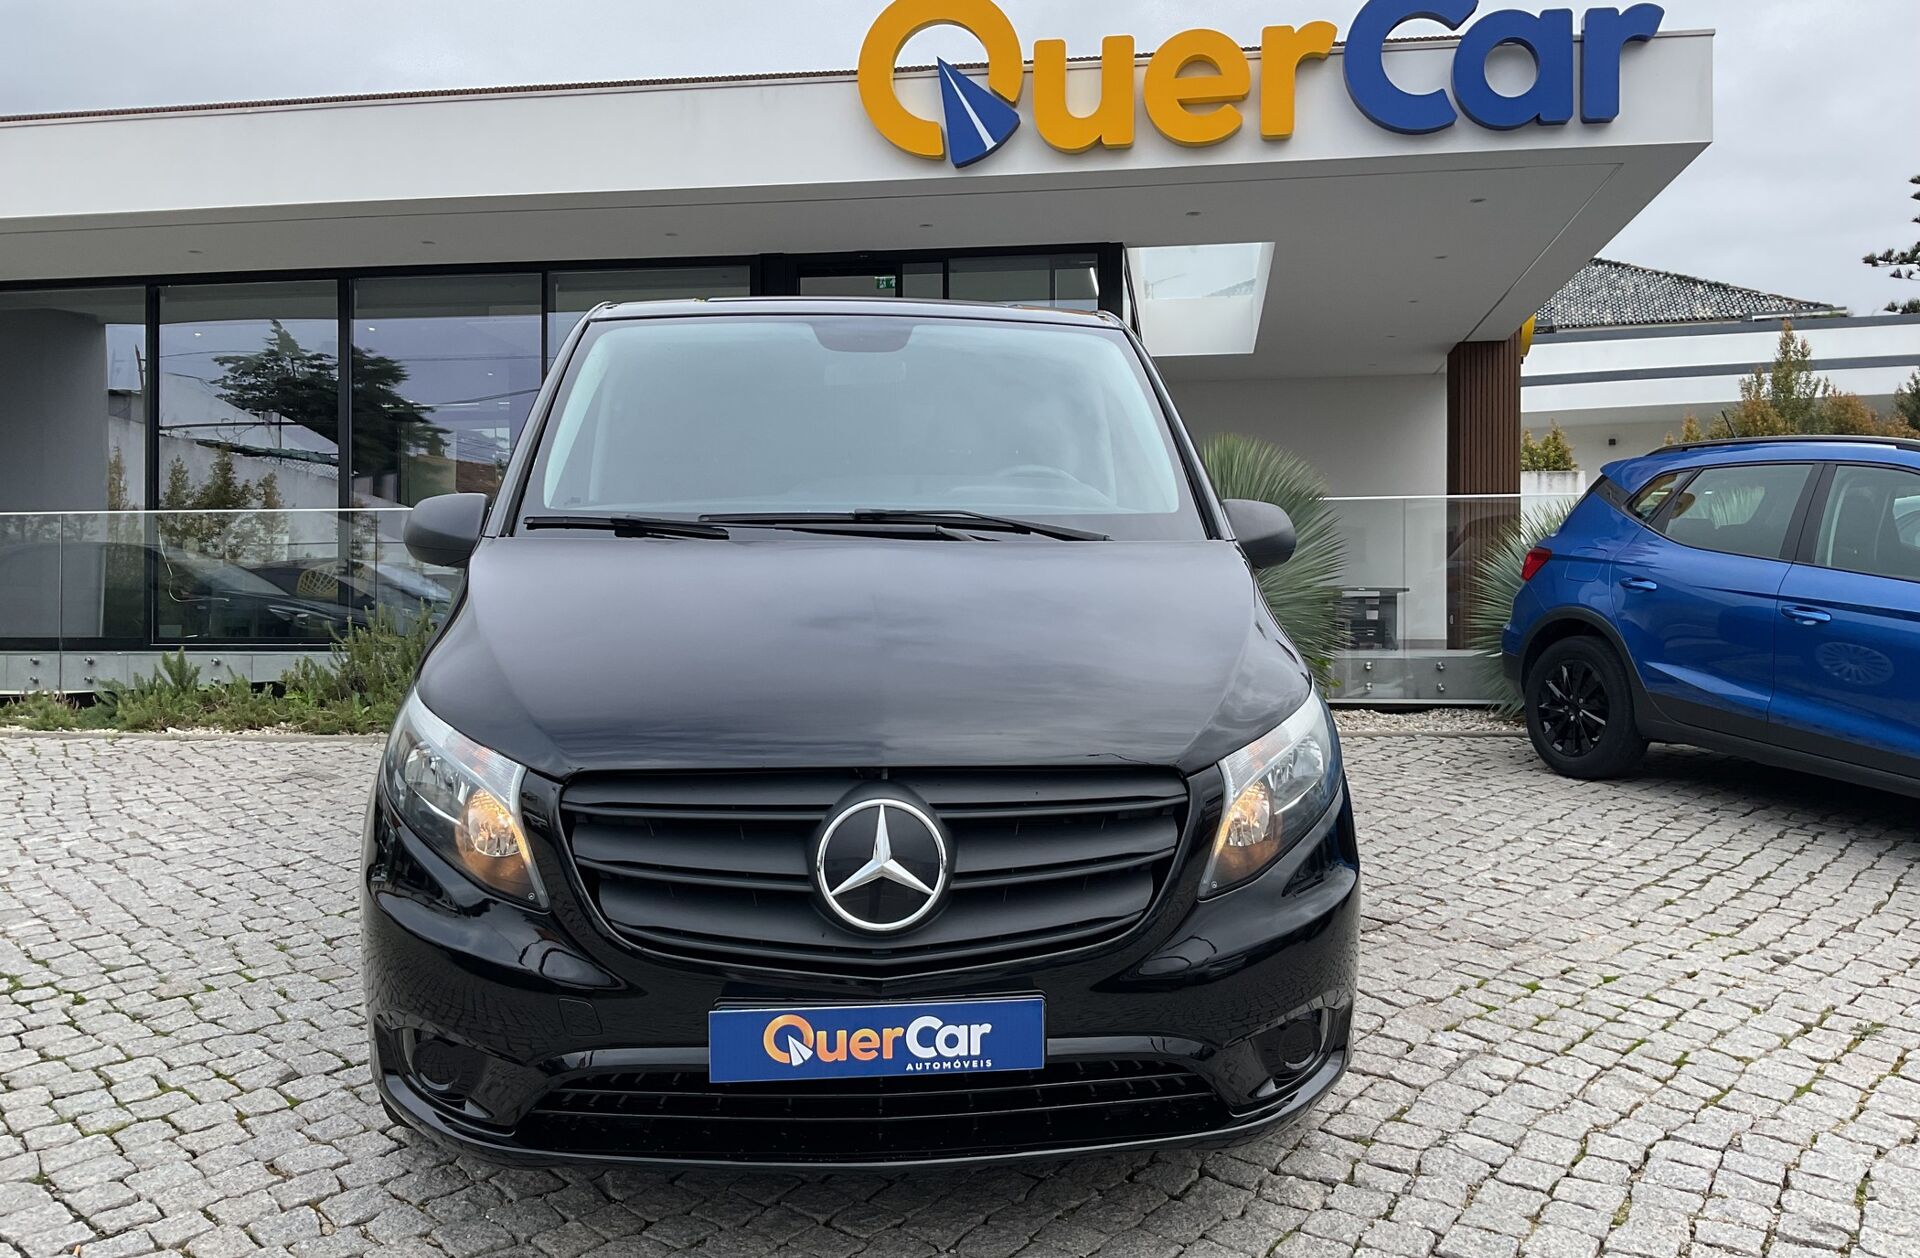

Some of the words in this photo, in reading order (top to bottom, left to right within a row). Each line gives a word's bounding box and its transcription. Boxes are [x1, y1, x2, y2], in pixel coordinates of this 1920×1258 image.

[857, 0, 1664, 168] QuerCar
[763, 1014, 992, 1066] QuerCar
[905, 1059, 992, 1071] AUTOMÓVEIS
